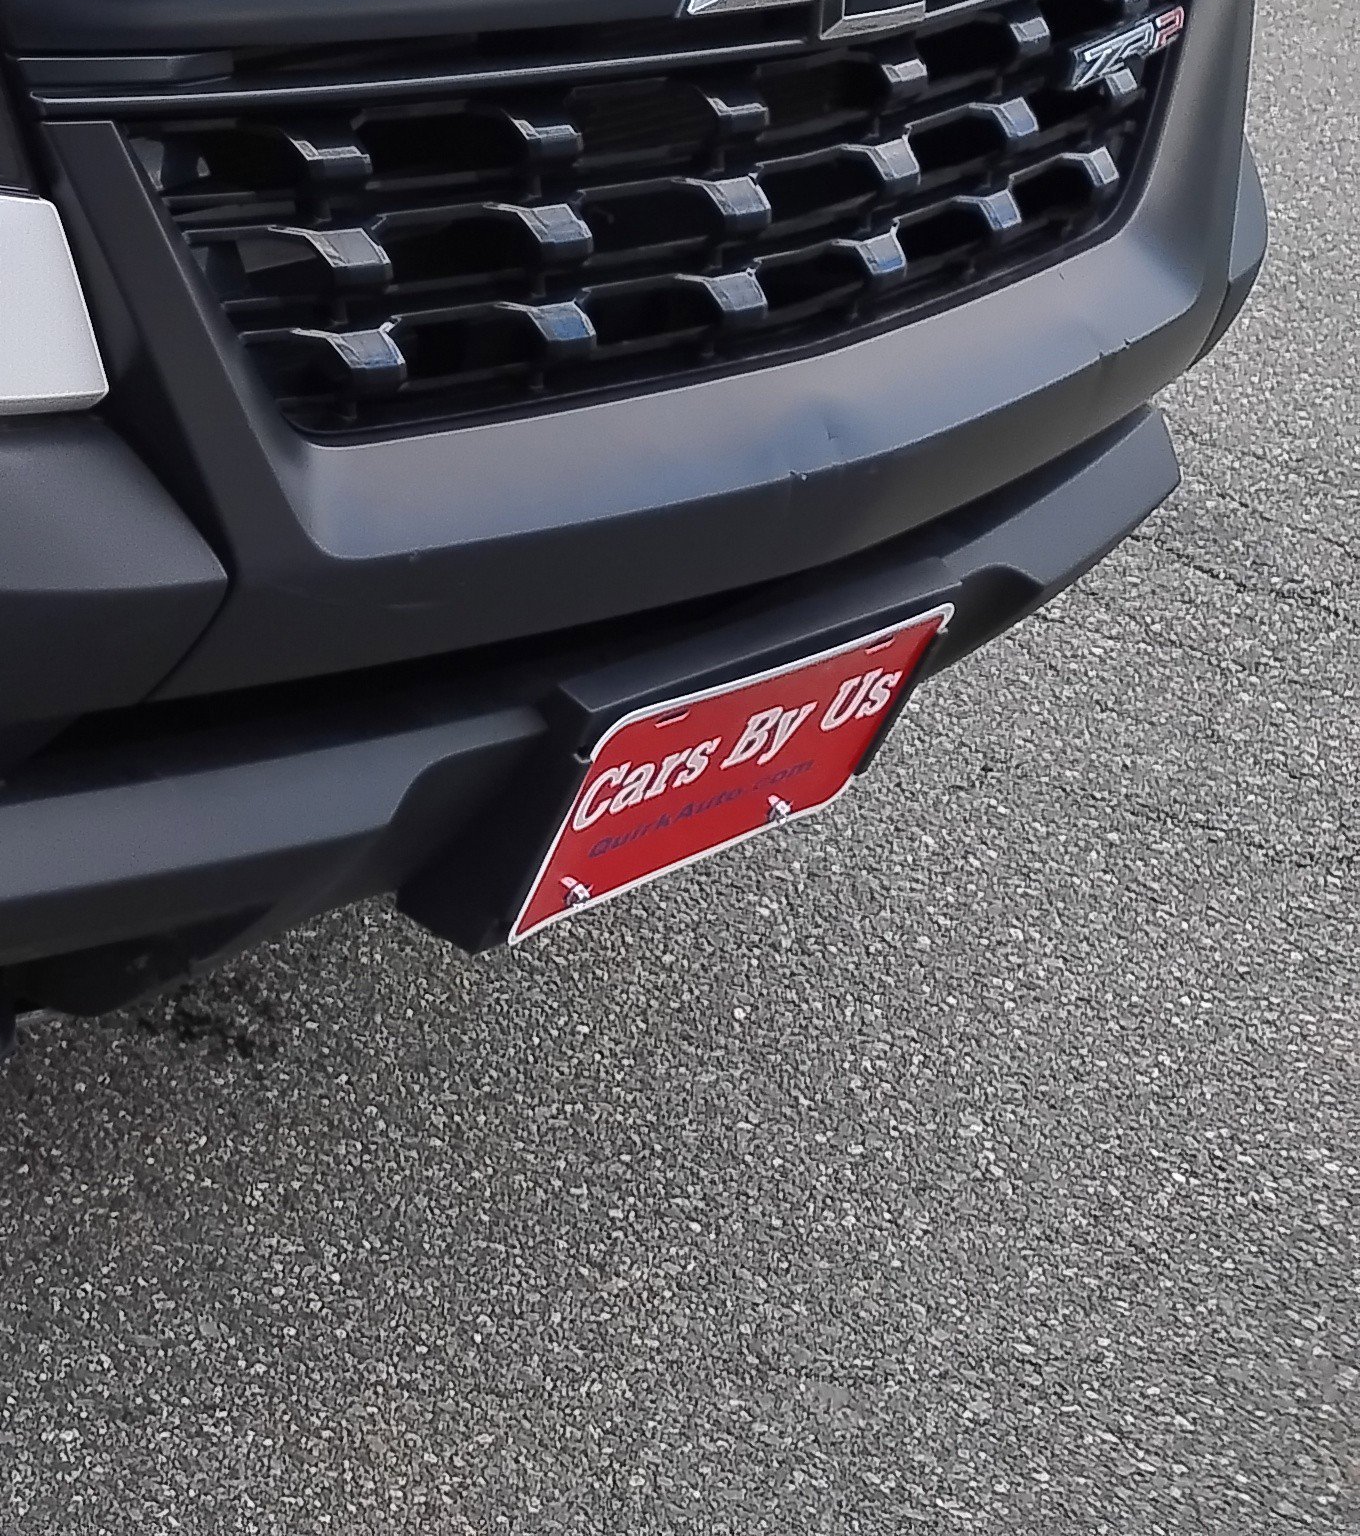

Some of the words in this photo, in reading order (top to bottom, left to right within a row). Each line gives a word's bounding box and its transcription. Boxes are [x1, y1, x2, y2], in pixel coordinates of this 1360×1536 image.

[1072, 5, 1185, 92] ZR2
[571, 735, 723, 832] Cars
[719, 699, 819, 771] By
[819, 666, 903, 733] Us
